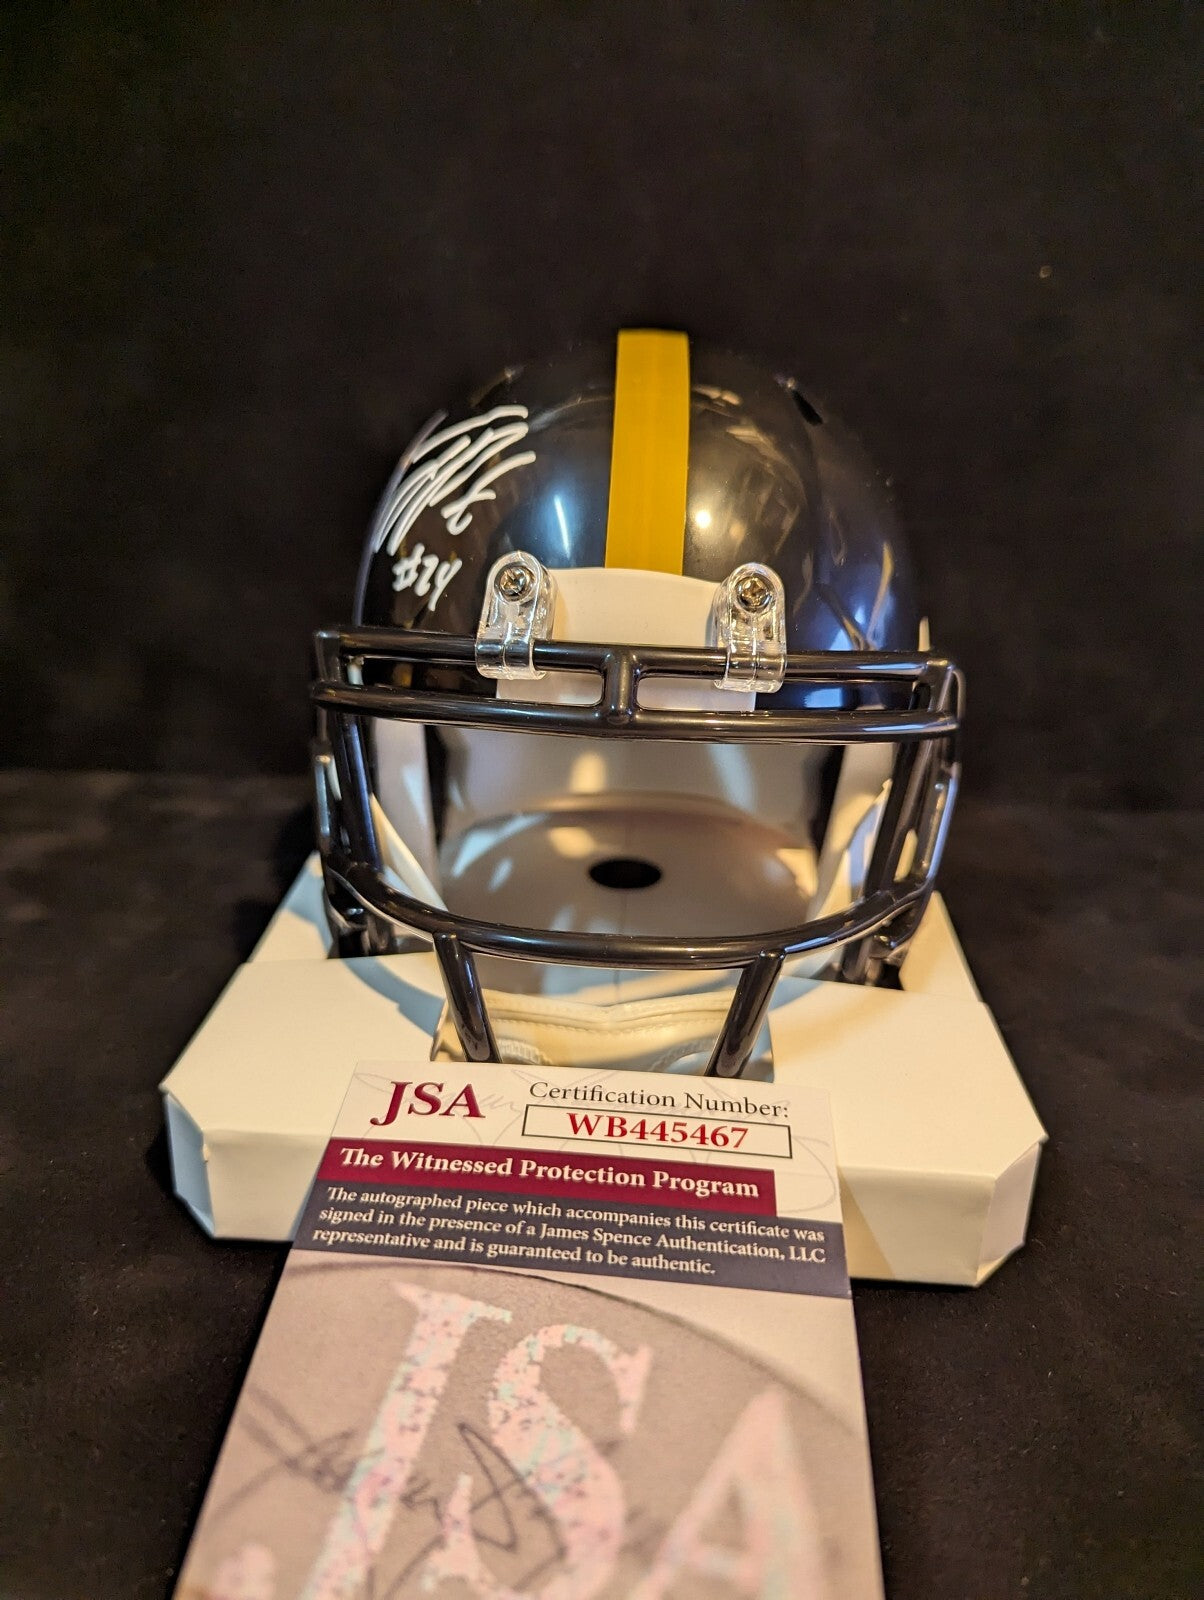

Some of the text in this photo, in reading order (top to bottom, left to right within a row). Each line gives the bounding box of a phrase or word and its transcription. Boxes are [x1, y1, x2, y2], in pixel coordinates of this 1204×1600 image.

[369, 1080, 486, 1127] JSA
[529, 1081, 789, 1118] Certification Number:
[566, 1112, 749, 1149] WB445467
[339, 1147, 760, 1198] The Witnessed Protection Program
[318, 1207, 827, 1264] signed in the presence of a James Spence Authentication, LLC
[327, 1186, 826, 1243] The autographed piece which accompanies this certificate was
[312, 1228, 717, 1276] representative and is guaranteed to be authentic.
